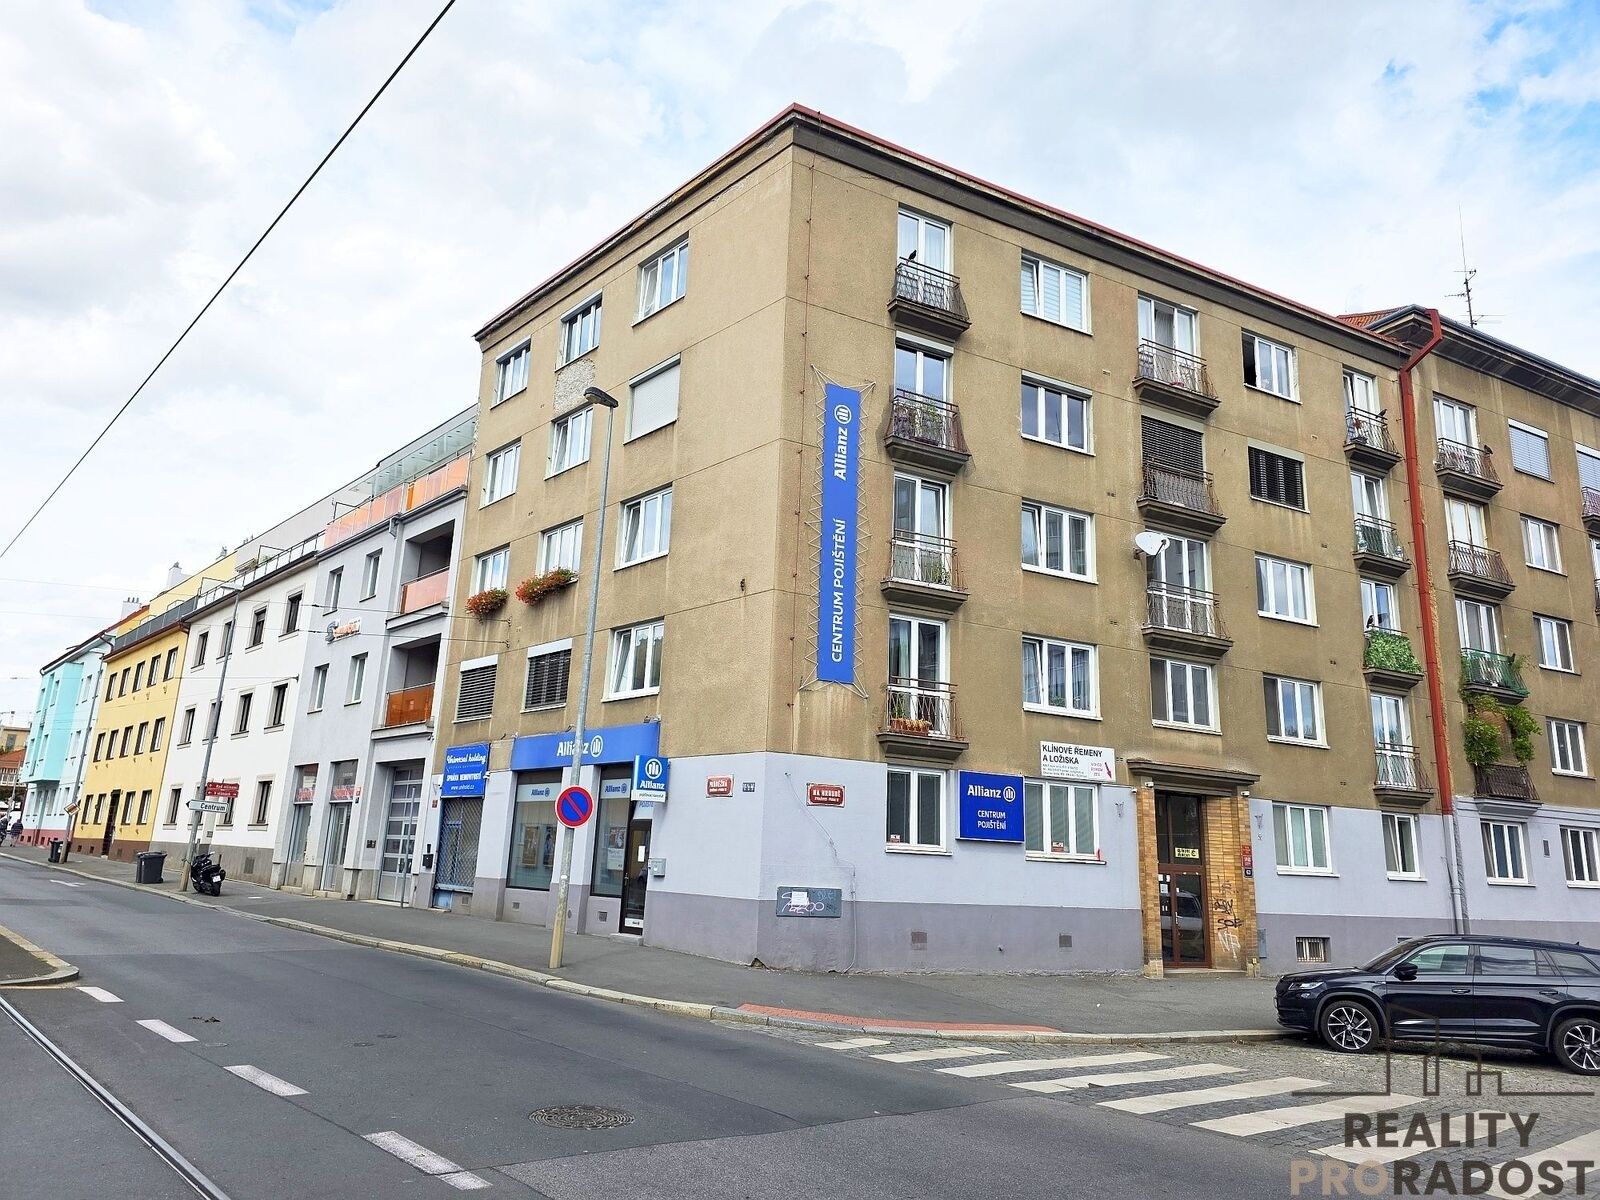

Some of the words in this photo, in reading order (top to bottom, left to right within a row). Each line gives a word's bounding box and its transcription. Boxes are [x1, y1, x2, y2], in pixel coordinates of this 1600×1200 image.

[833, 426, 848, 481] Allianz
[831, 518, 846, 589] POJIŠTĚNÍ
[831, 592, 844, 662] CENTRUM
[1042, 743, 1073, 755] KLÍNOVÉ
[1074, 746, 1103, 758] ŘEMENY
[1042, 754, 1049, 762] A
[1049, 754, 1080, 765] LOŽISKA
[604, 784, 621, 793] Allianz
[639, 779, 666, 790] Allianz
[530, 788, 545, 796] Allianz
[967, 784, 1002, 799] Allianz
[200, 802, 226, 811] Centrum
[977, 809, 1006, 819] CENTRUM
[977, 819, 1007, 830] POJIŠTĚNÍ
